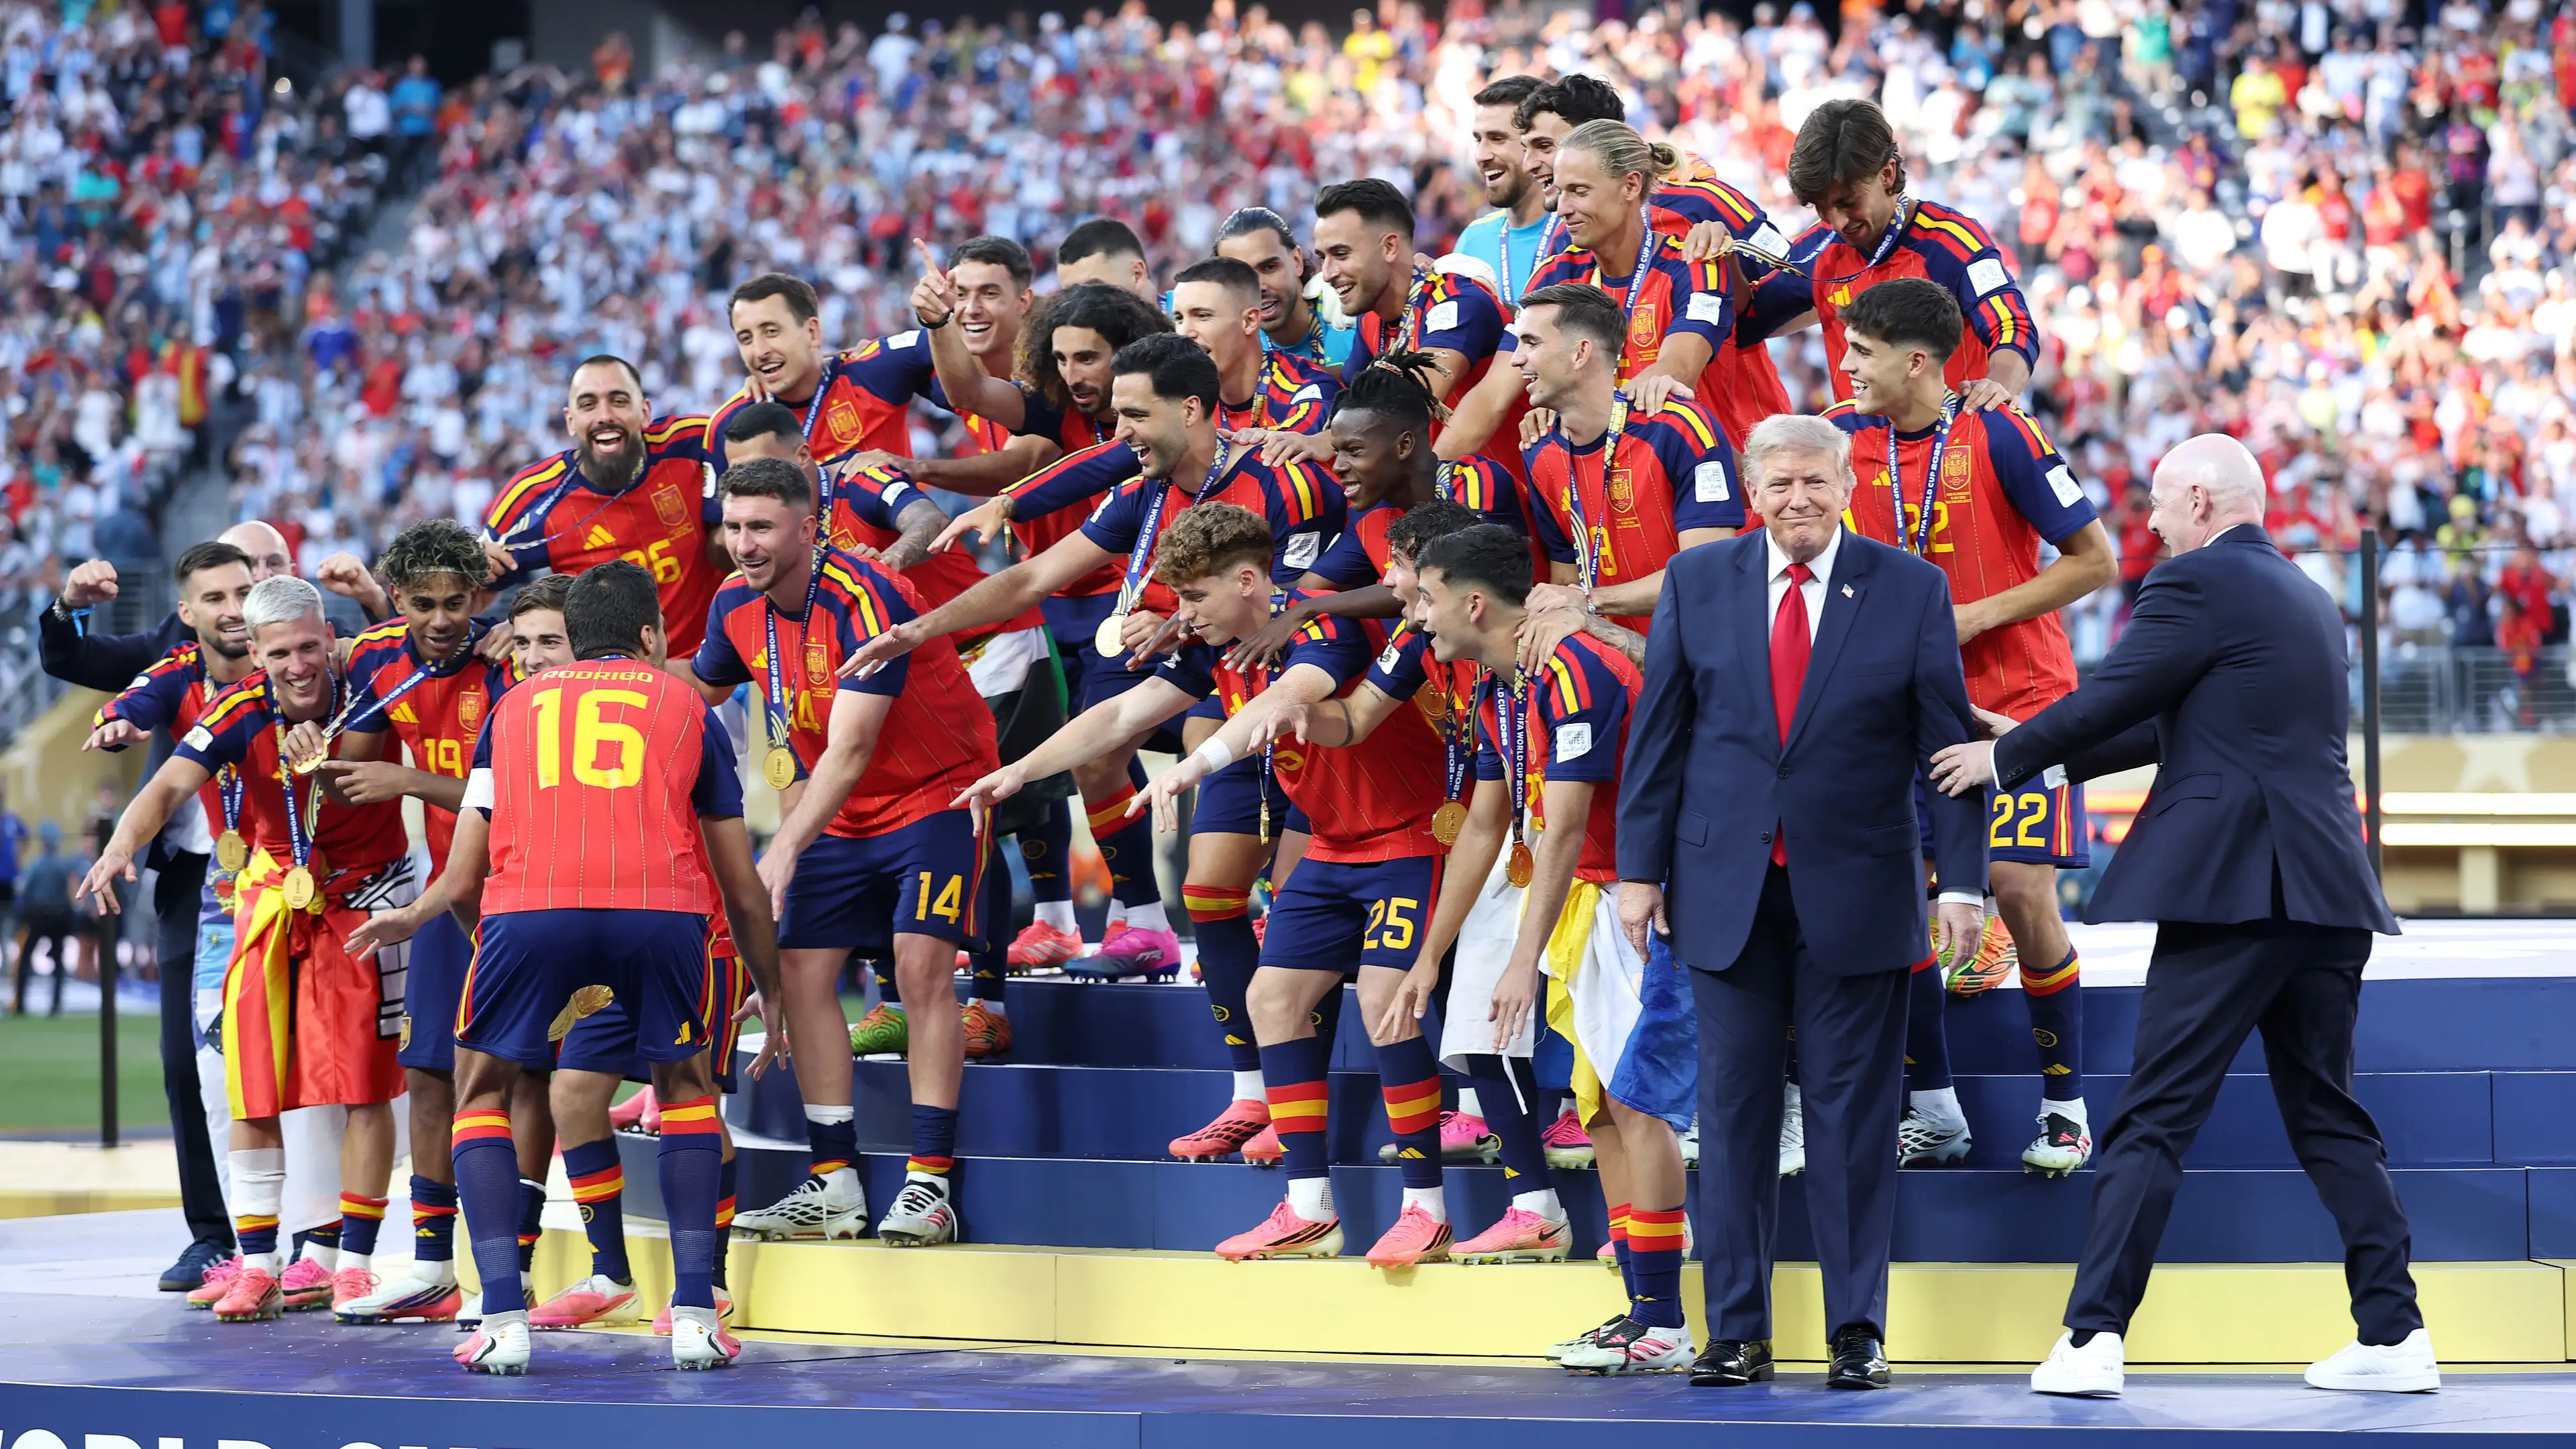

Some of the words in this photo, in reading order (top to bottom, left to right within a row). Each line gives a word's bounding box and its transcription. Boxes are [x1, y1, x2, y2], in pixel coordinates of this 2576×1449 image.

[1537, 234, 1549, 251] CUP
[1639, 246, 1650, 263] CUP
[1872, 233, 1893, 259] 2026
[1500, 260, 1509, 286] WORLD
[1630, 262, 1646, 291] WORLD
[1503, 286, 1511, 301] CUP
[1625, 290, 1636, 309] FIFA
[800, 417, 812, 437] ORLD
[1930, 441, 1941, 470] 2026
[820, 481, 828, 496] FIFA
[1201, 475, 1214, 492] FIFA
[1889, 452, 1897, 481] WORLD
[1894, 499, 1902, 528] 2026
[1927, 471, 1935, 488] CUP
[1152, 492, 1163, 508] FIFA
[1921, 488, 1933, 519] WORLD
[1144, 508, 1158, 535] WORLD
[1903, 501, 1955, 553] 22
[1918, 518, 1927, 537] FIFA
[1139, 533, 1149, 549] CUP
[1130, 548, 1144, 574] 2026
[808, 582, 816, 599] FIFA
[767, 631, 776, 659] WORLD
[541, 670, 653, 683] RODRIGO
[771, 676, 780, 703] 2026
[1496, 676, 1504, 697] ORLD
[366, 696, 390, 714] WORLD
[388, 686, 402, 699] CUP
[400, 670, 425, 690] 2026
[1498, 698, 1506, 715] CUP
[531, 688, 649, 790] 16
[1499, 716, 1509, 746] 2026
[425, 739, 463, 779] 19
[1453, 763, 1464, 791] 2026
[223, 796, 231, 812] FIFA
[286, 796, 294, 814] FIFA
[288, 813, 299, 841] WORLD
[1990, 793, 2047, 848] 22
[292, 841, 301, 857] CUP
[915, 871, 963, 924] 14
[1363, 897, 1418, 950] 25
